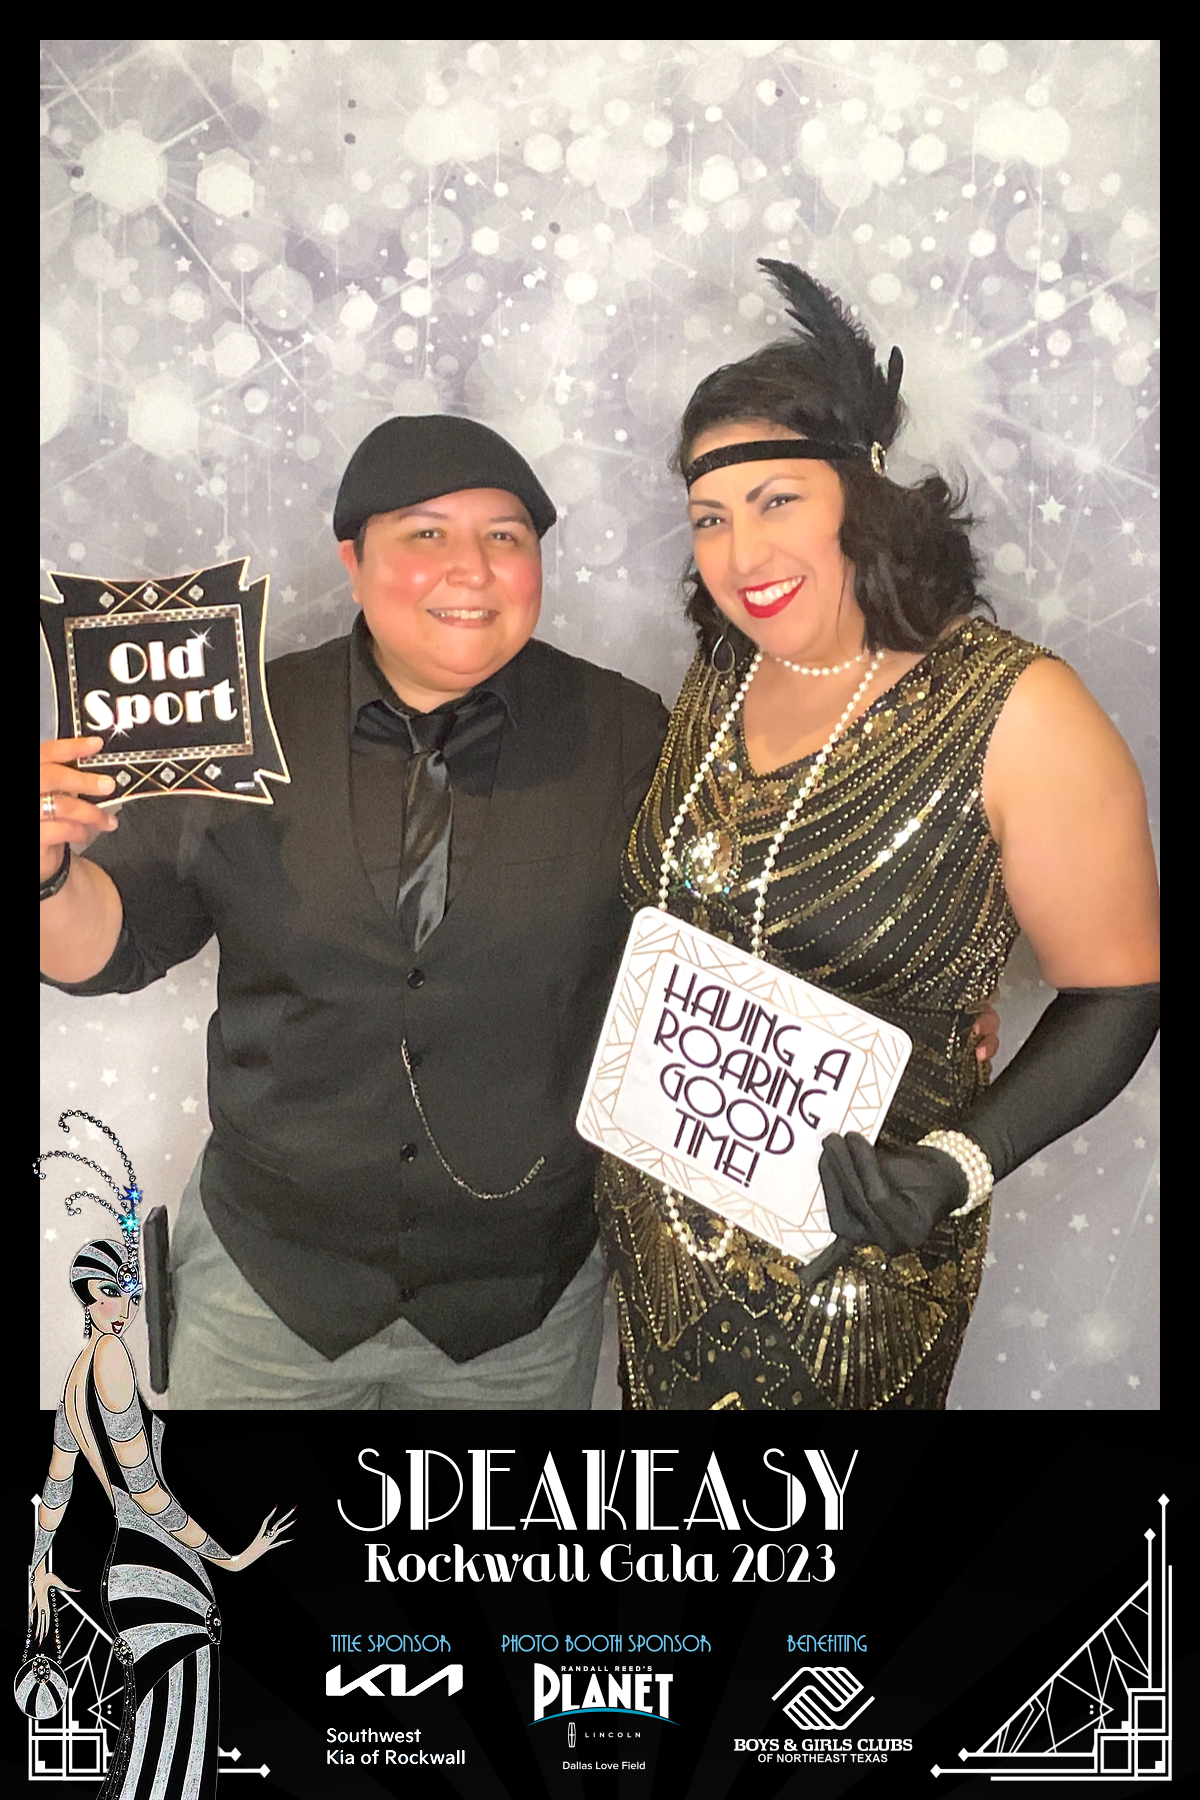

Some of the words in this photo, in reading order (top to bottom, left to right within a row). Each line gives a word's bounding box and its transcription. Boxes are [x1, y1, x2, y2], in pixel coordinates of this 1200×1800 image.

[108, 636, 206, 685] Old
[83, 678, 238, 731] Sport
[654, 1007, 827, 1129] ROARING
[664, 964, 801, 1066] HAVING
[814, 1048, 851, 1091] A
[659, 1064, 794, 1155] GOOD
[674, 1108, 760, 1188] TIME!
